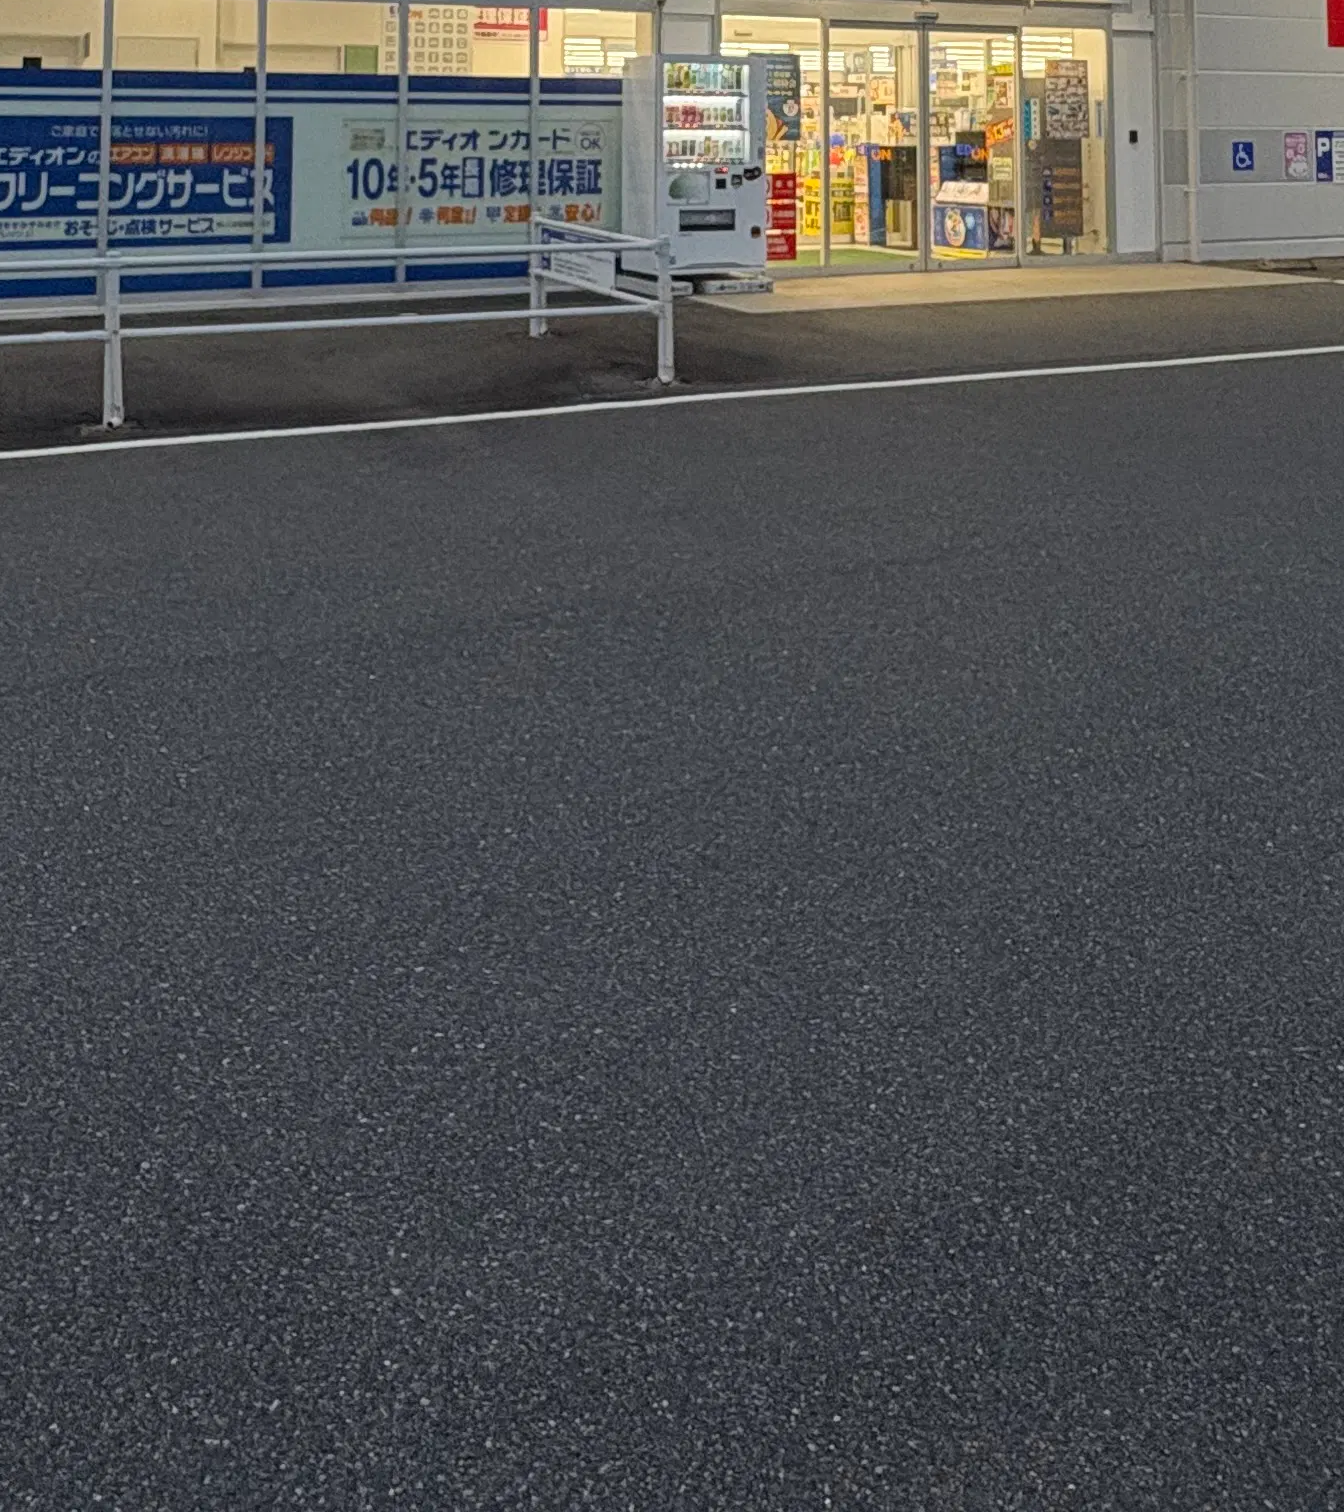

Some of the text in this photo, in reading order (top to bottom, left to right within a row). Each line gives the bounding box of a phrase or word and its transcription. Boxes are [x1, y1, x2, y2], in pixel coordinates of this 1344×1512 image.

[580, 137, 602, 151] OK
[1317, 137, 1331, 158] P
[63, 218, 213, 236] おそじ・点検サービス
